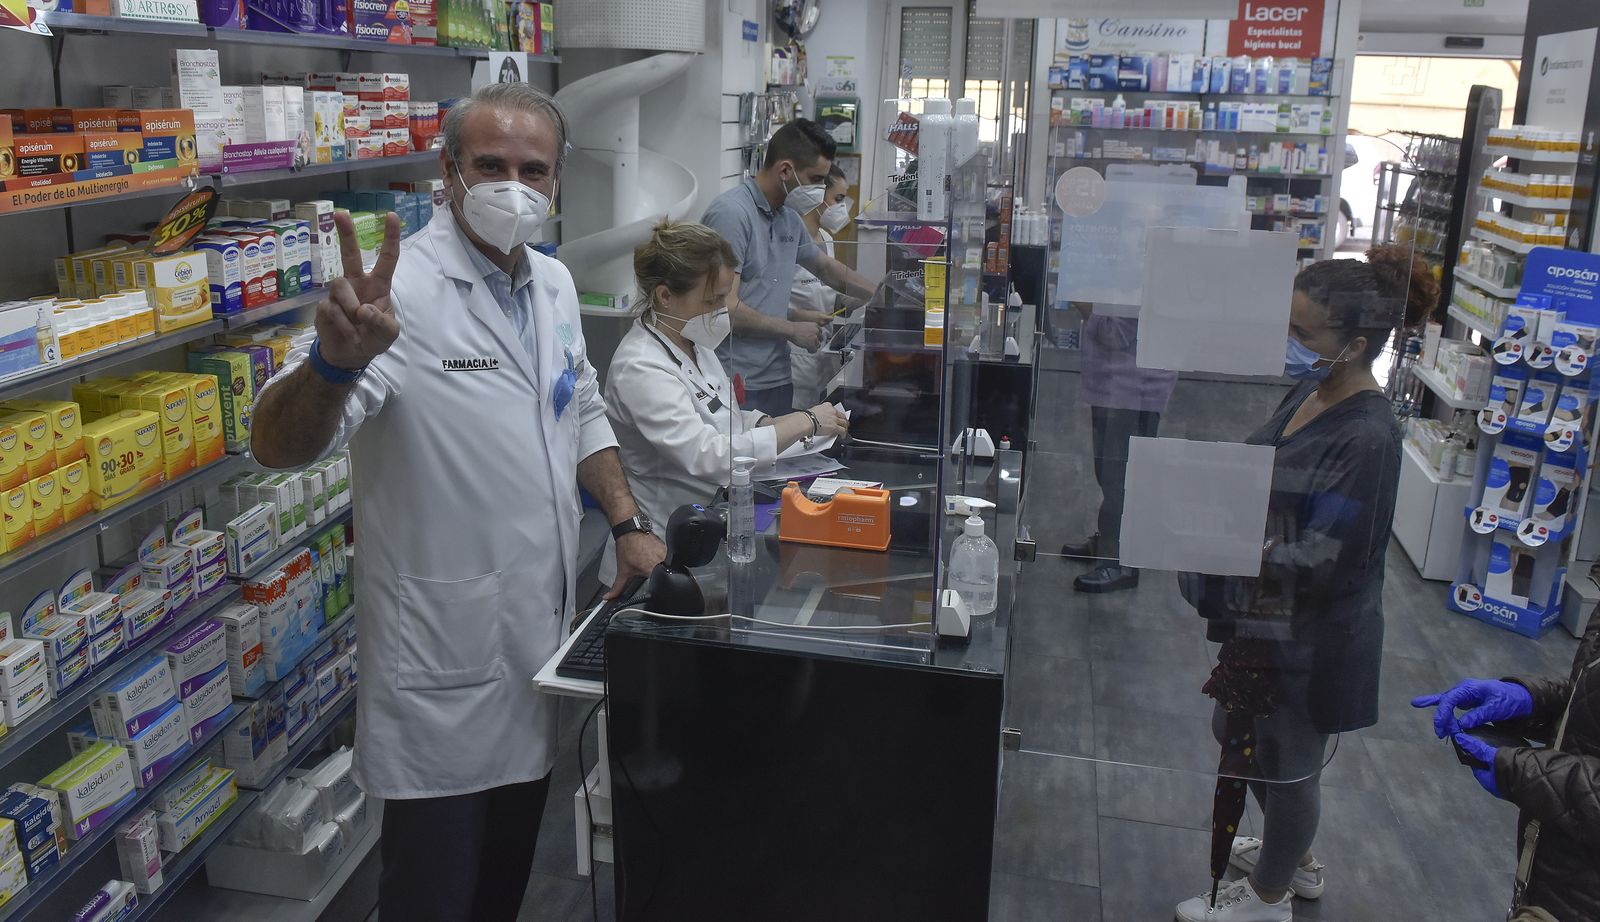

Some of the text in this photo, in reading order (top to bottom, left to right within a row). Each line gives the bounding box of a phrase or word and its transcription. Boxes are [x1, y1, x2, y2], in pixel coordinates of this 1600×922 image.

[354, 1, 387, 11] fisiocrem
[1244, 3, 1308, 21] Lacer
[356, 24, 388, 36] fisiocrem
[1098, 18, 1188, 39] Cansino
[1247, 26, 1302, 38] Especialistas
[1244, 40, 1301, 51] higiene bucal
[79, 116, 117, 129] apisérum
[145, 117, 181, 131] apisérum
[888, 123, 918, 132] HALLS
[20, 141, 53, 153] apisérum
[89, 137, 117, 149] apisérum
[254, 148, 267, 156] Alivia
[31, 179, 52, 187] Vitalidad
[888, 173, 918, 183] Trident
[13, 194, 23, 206] El
[25, 192, 51, 204] Poder
[54, 188, 65, 200] de
[66, 186, 76, 198] la
[154, 202, 206, 247] 30%
[892, 269, 925, 280] Trident
[1547, 266, 1599, 281] aposán
[442, 359, 487, 369] FARMACIA
[221, 385, 235, 441] prevent
[837, 515, 874, 523] ratiopharm
[134, 601, 165, 623] Multicentrum
[183, 640, 212, 664] kaleidon
[126, 668, 166, 701] kaleidon 30
[143, 721, 173, 748] kaleidon
[76, 760, 124, 799] kaleidon 60
[24, 799, 59, 829] kaleidon
